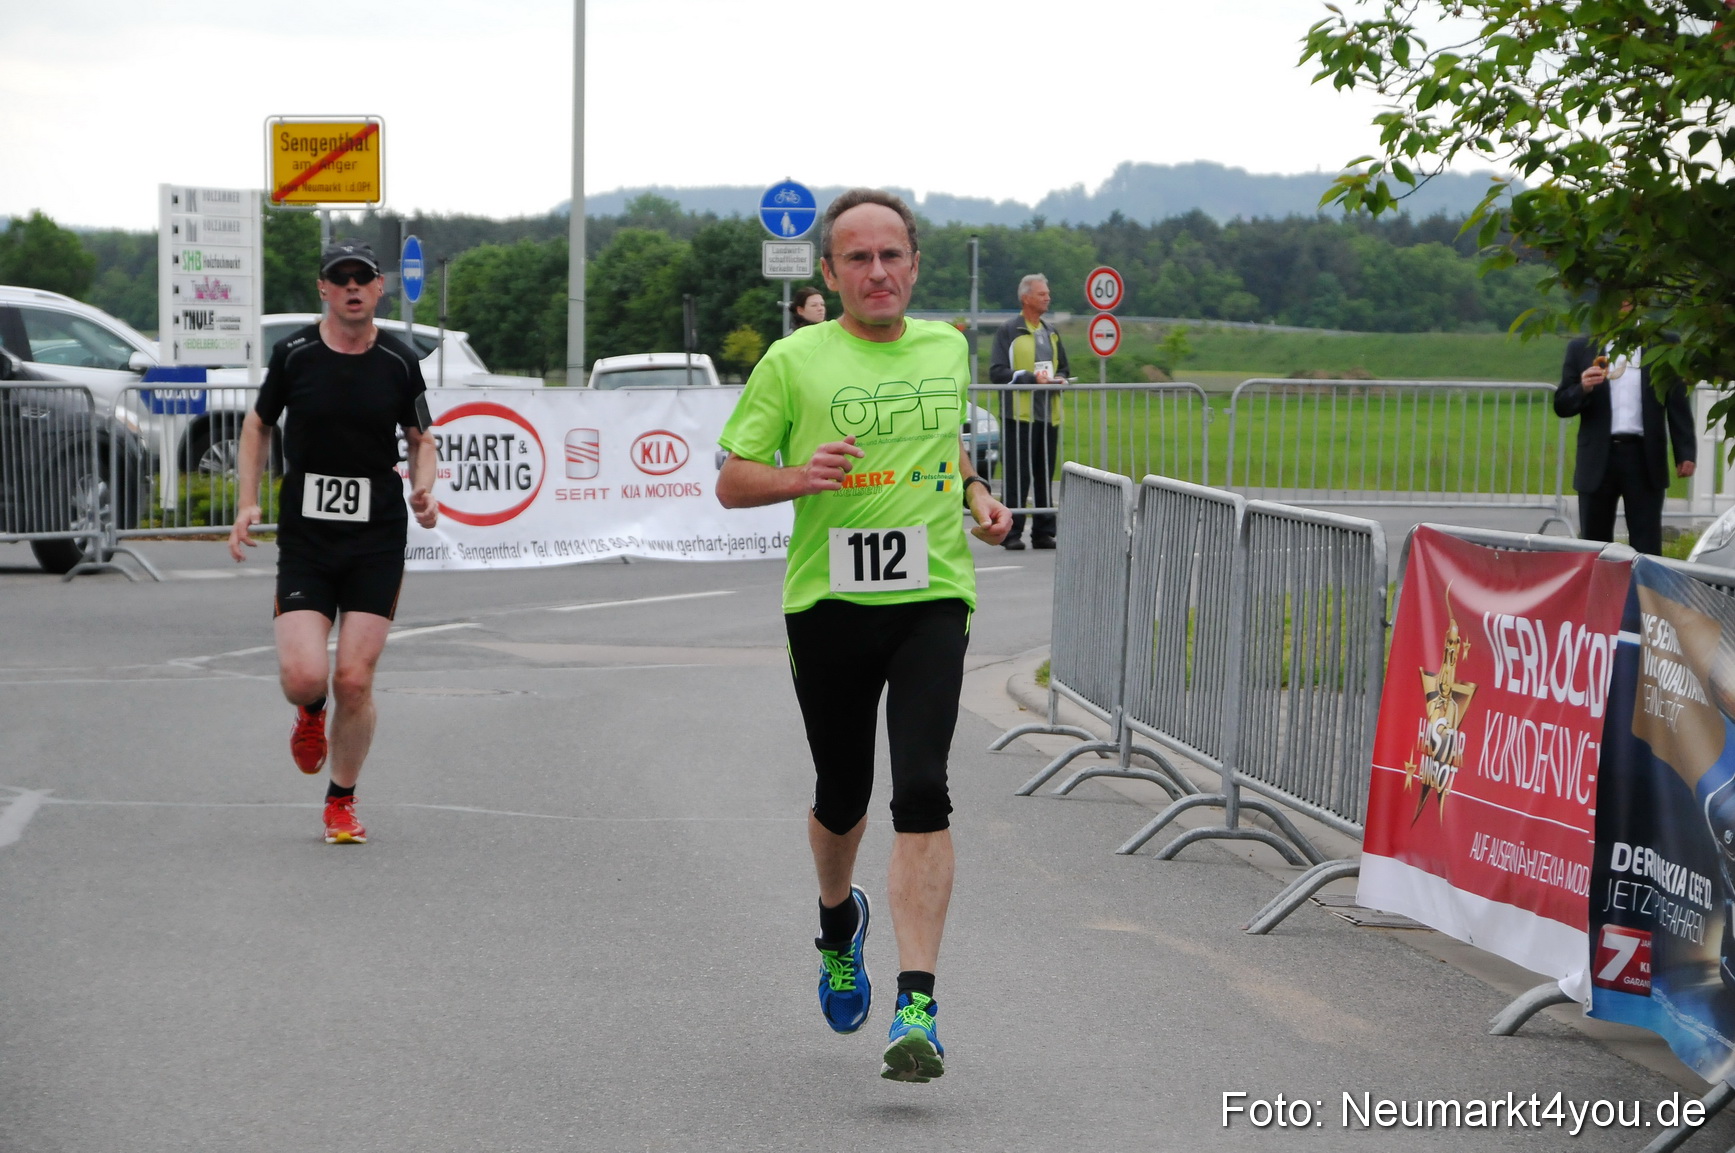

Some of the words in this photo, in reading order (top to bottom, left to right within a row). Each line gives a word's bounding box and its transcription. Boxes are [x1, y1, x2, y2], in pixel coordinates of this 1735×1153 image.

[280, 131, 370, 157] Sengenthal
[292, 160, 312, 170] am
[319, 158, 358, 173] Anger
[302, 181, 342, 193] Neumarkt
[1094, 279, 1115, 299] 60
[182, 309, 214, 330] THULE
[831, 377, 958, 438] OPF
[516, 440, 528, 454] &
[640, 441, 678, 464] KIA
[450, 461, 532, 491] JÄNIG
[841, 470, 896, 488] MERZ
[315, 477, 360, 515] 129
[555, 487, 610, 500] SEAT
[621, 484, 641, 499] KIA
[644, 482, 702, 498] MOTORS
[457, 541, 521, 564] Sengenthal
[530, 540, 552, 559] Tel.
[648, 531, 791, 556] www.gerhart-jaenig.de
[847, 530, 907, 581] 112
[1469, 831, 1491, 862] AUF
[1610, 842, 1654, 878] DER
[1602, 878, 1653, 915] JETZ
[1597, 931, 1641, 982] 7
